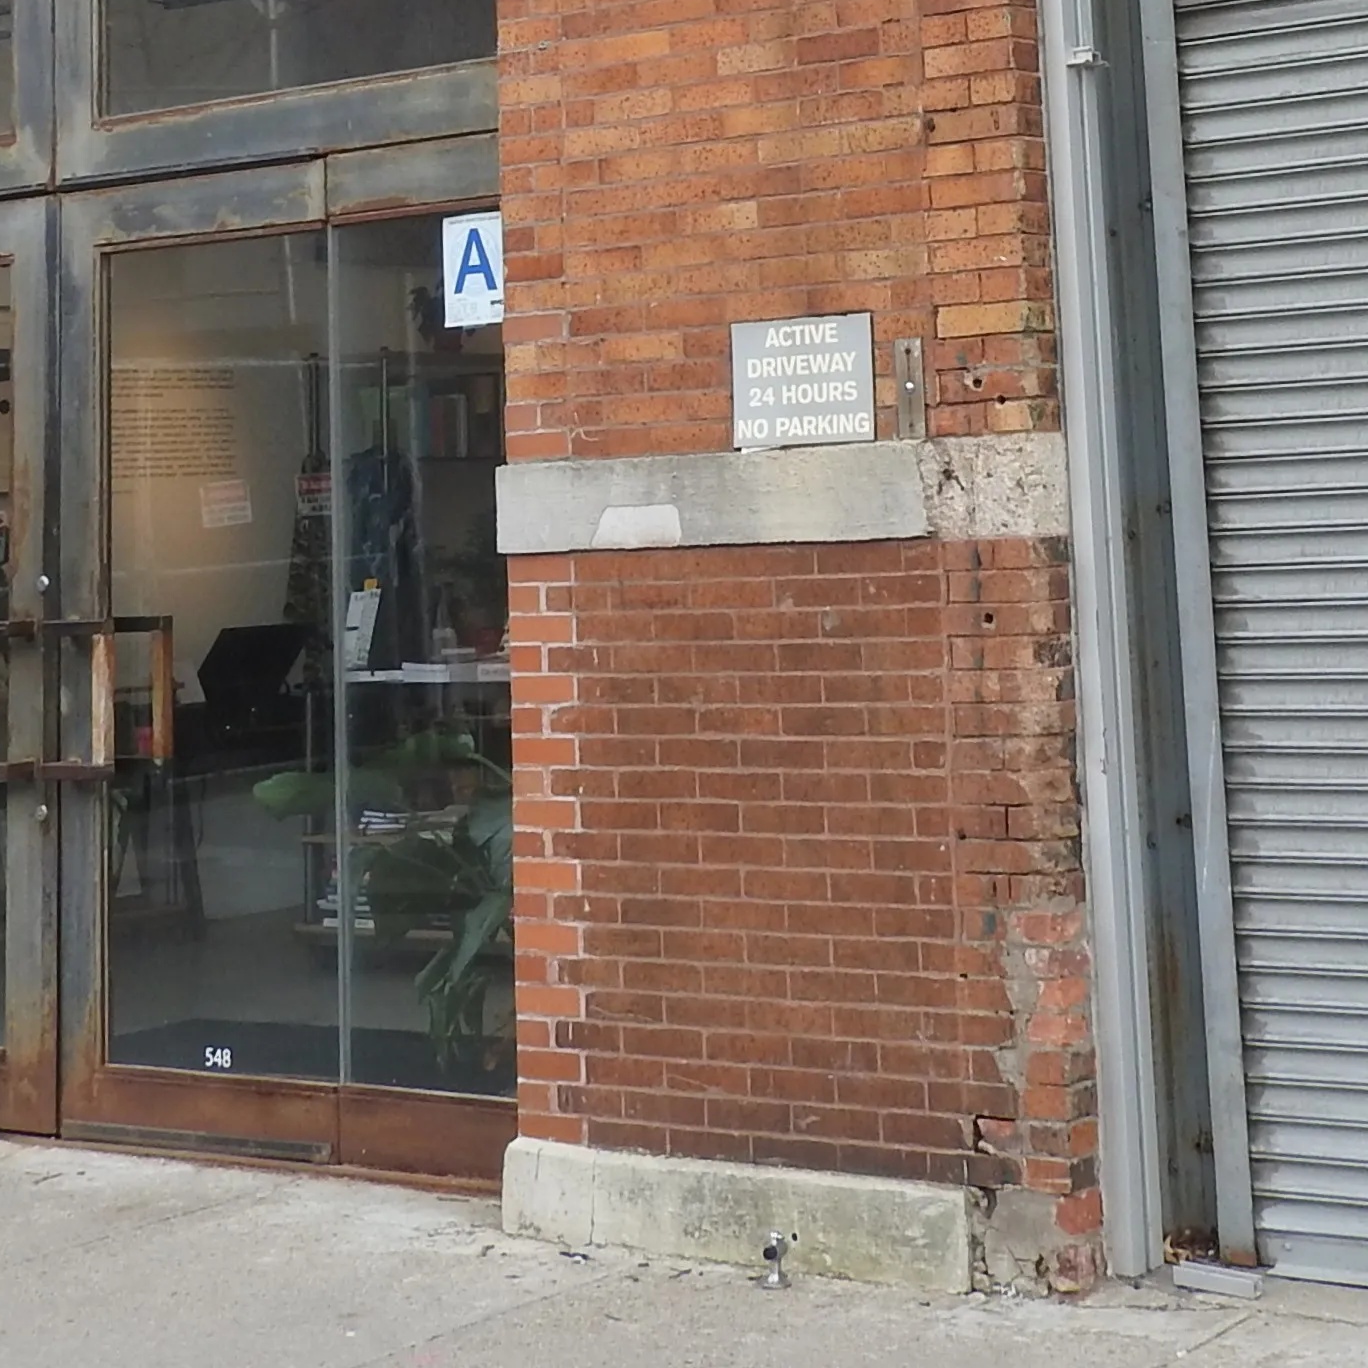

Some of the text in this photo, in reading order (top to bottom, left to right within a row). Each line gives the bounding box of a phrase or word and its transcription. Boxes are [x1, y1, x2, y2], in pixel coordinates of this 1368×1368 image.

[453, 227, 498, 295] A
[764, 322, 839, 349] ACTIVE
[747, 351, 857, 379] DRIVEWAY
[748, 380, 858, 408] 24 HOURS
[736, 411, 871, 440] NO PARKING
[205, 1046, 232, 1069] 548
